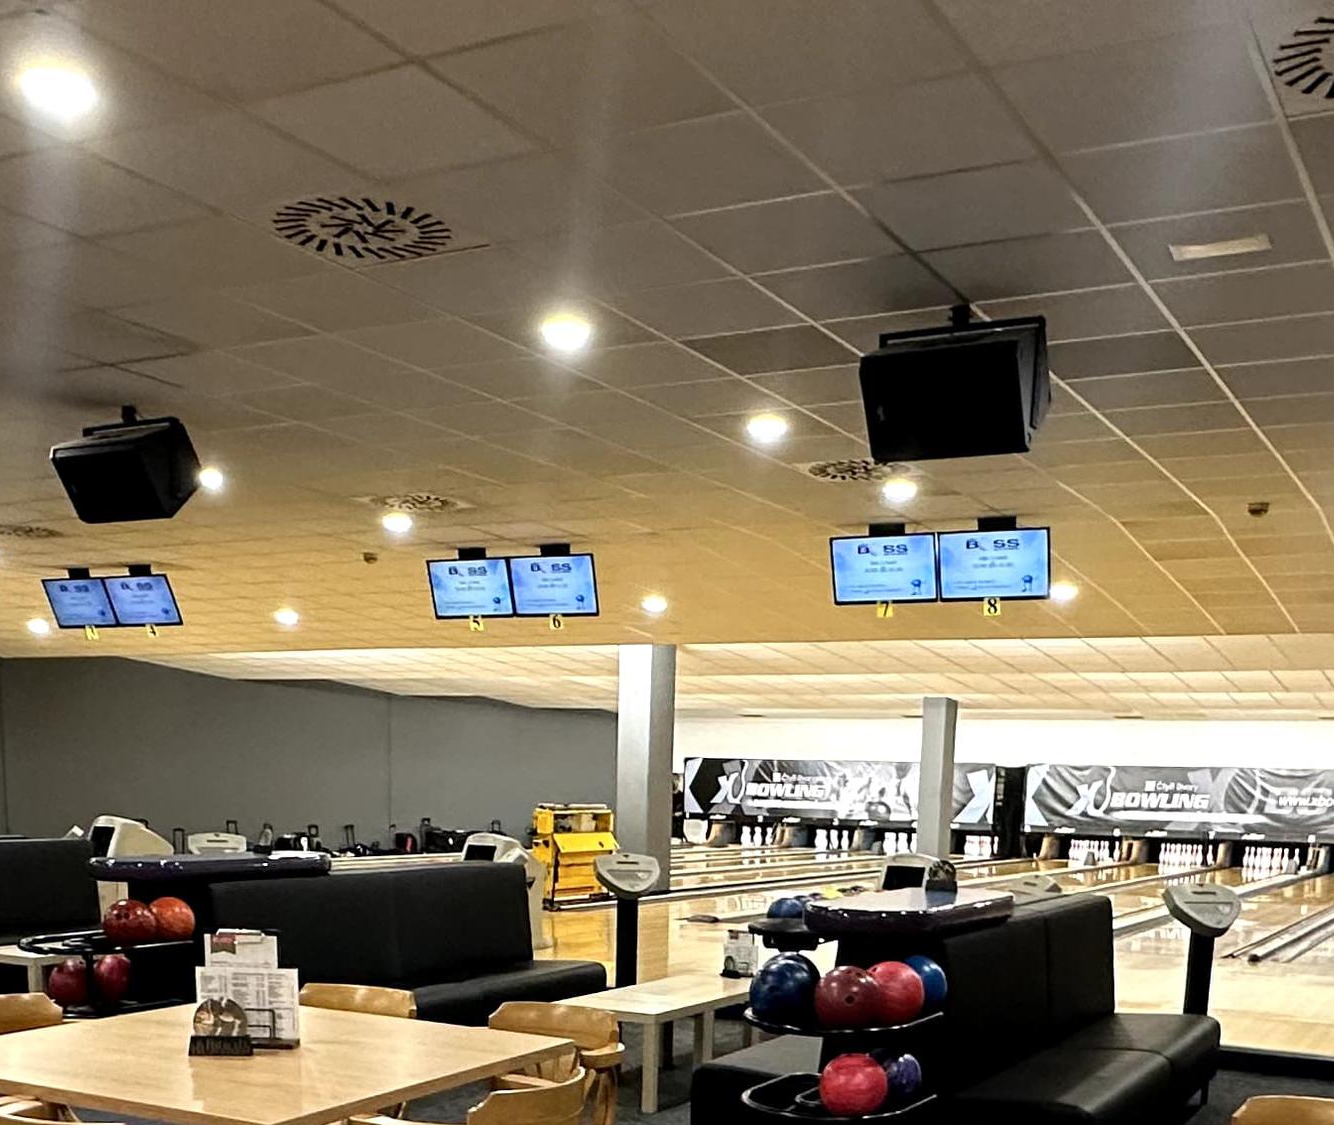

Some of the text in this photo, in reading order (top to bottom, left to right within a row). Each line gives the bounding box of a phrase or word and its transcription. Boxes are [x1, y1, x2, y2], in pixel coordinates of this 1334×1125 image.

[881, 601, 891, 617] 7
[986, 598, 998, 615] 8
[552, 613, 562, 629] 6
[745, 782, 825, 799] BOWLING
[1109, 791, 1212, 809] BOWLING
